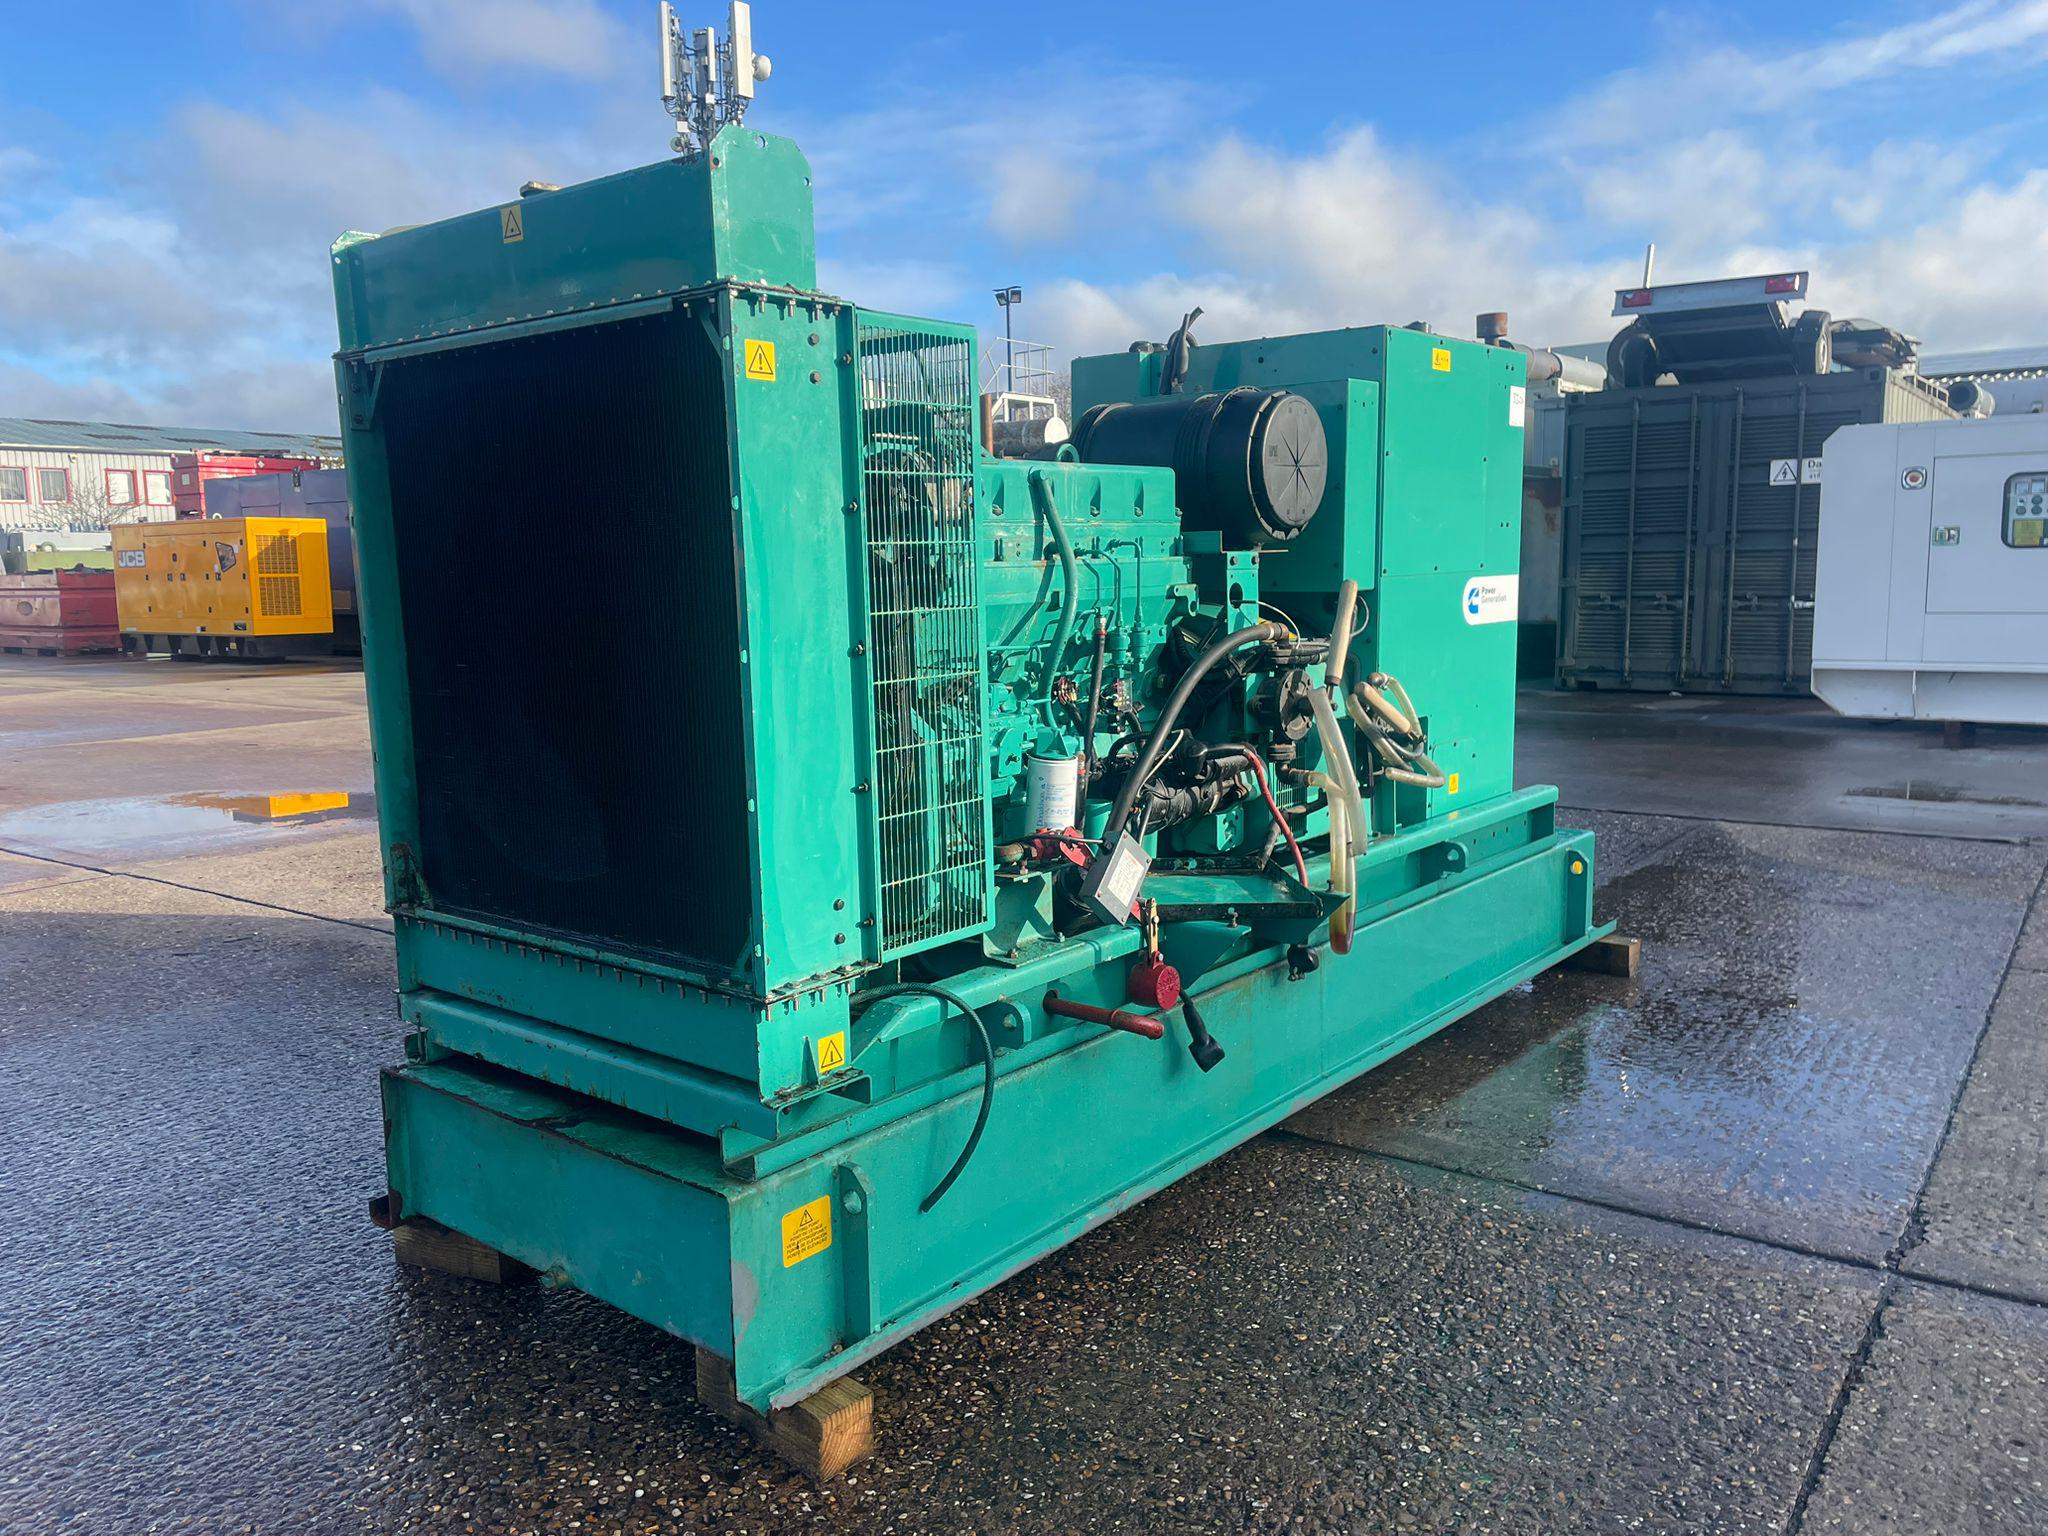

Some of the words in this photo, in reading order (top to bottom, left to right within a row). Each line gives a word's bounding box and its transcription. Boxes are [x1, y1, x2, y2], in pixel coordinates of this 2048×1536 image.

[118, 551, 145, 566] JCB
[1481, 586, 1496, 595] Power
[1481, 593, 1507, 603] Generation
